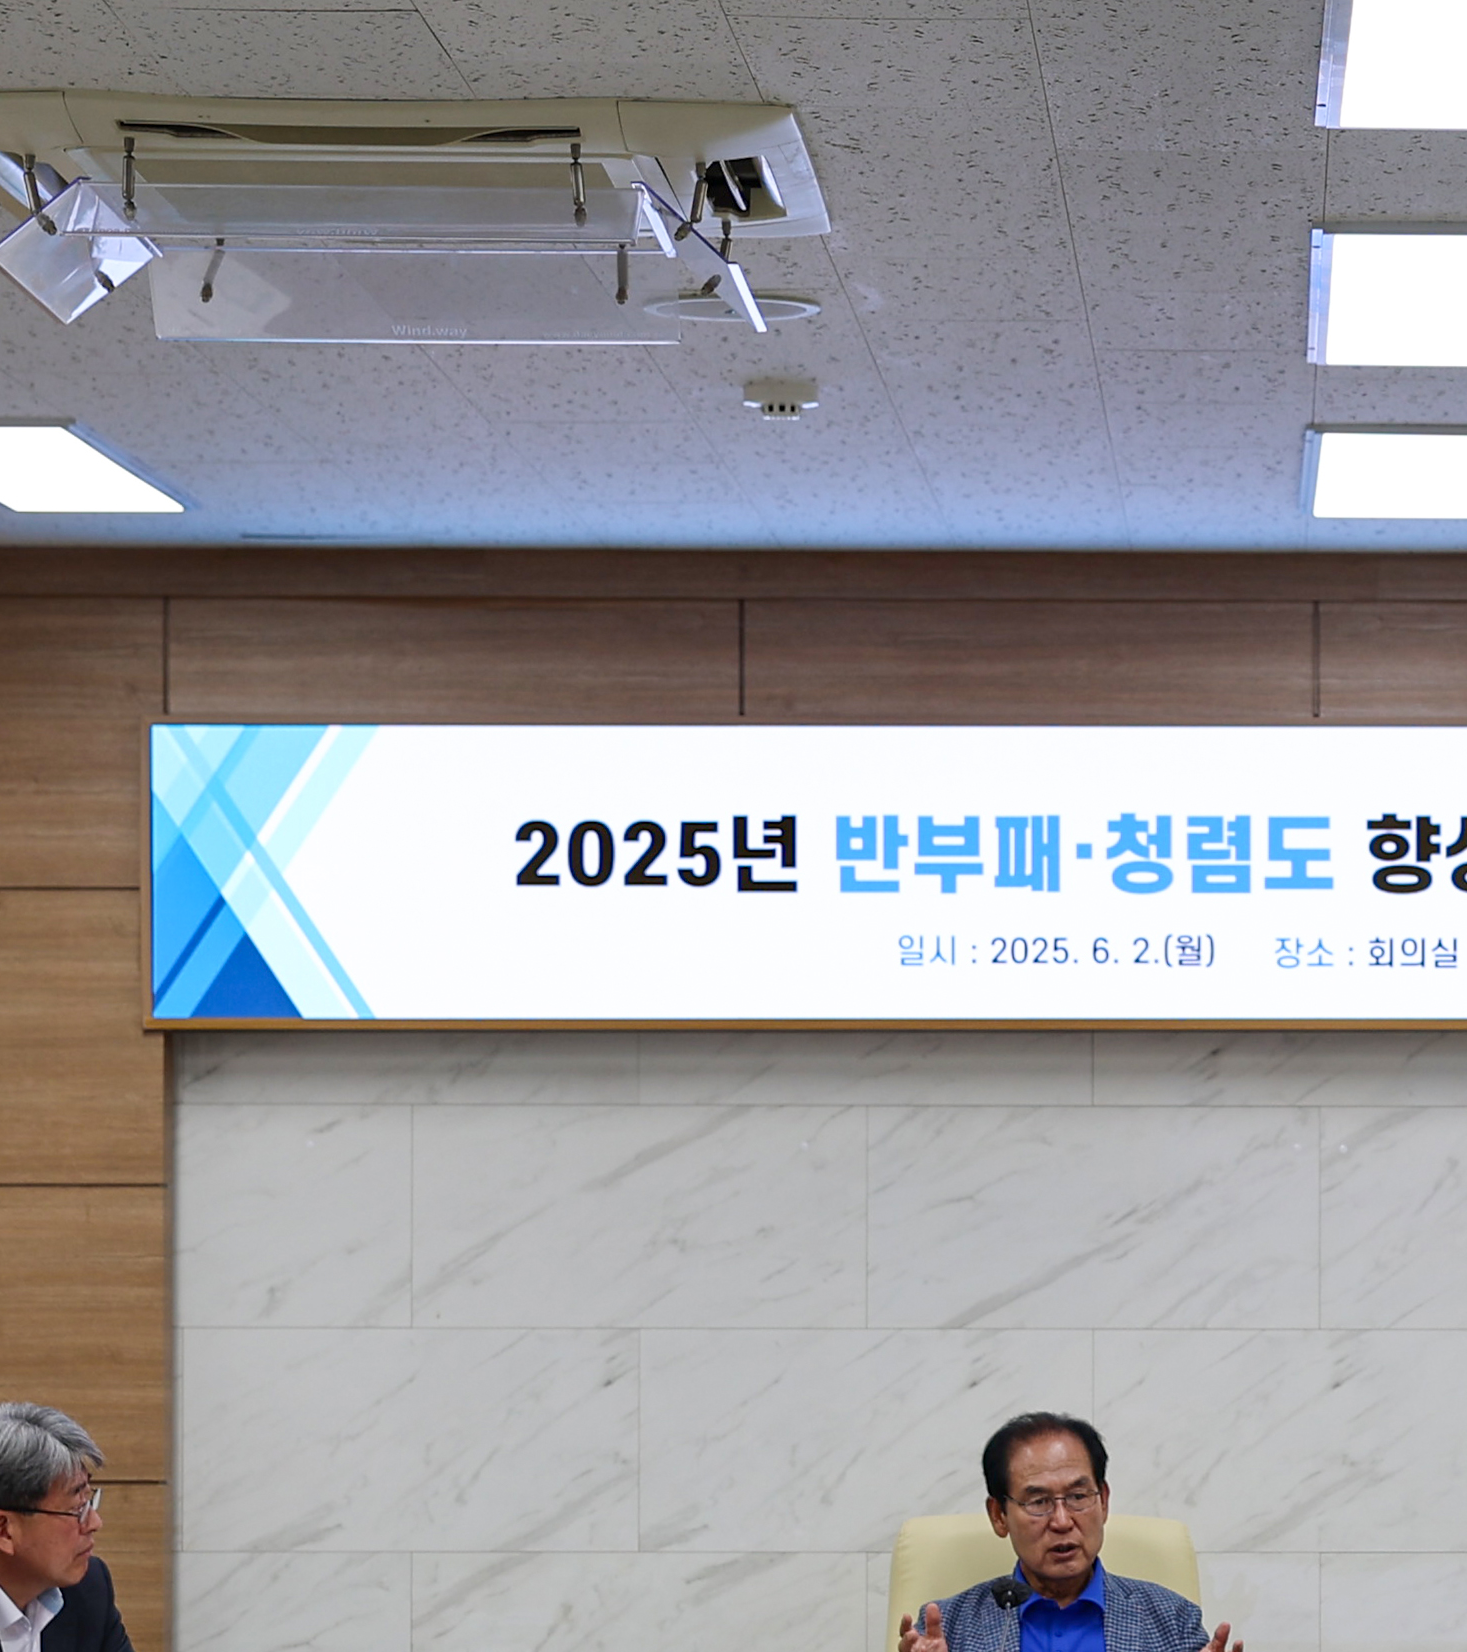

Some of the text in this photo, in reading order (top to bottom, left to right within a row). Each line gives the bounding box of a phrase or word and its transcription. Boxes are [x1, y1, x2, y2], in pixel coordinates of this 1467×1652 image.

[515, 814, 798, 894] 2025년
[835, 813, 1335, 895] 반부패·청렴도
[898, 934, 957, 967] 일시
[991, 936, 1079, 965] 2025.
[1092, 936, 1120, 965] 6.
[1132, 934, 1216, 968] 2.(월)
[1275, 936, 1334, 969] 장소
[1369, 936, 1459, 969] 회의실
